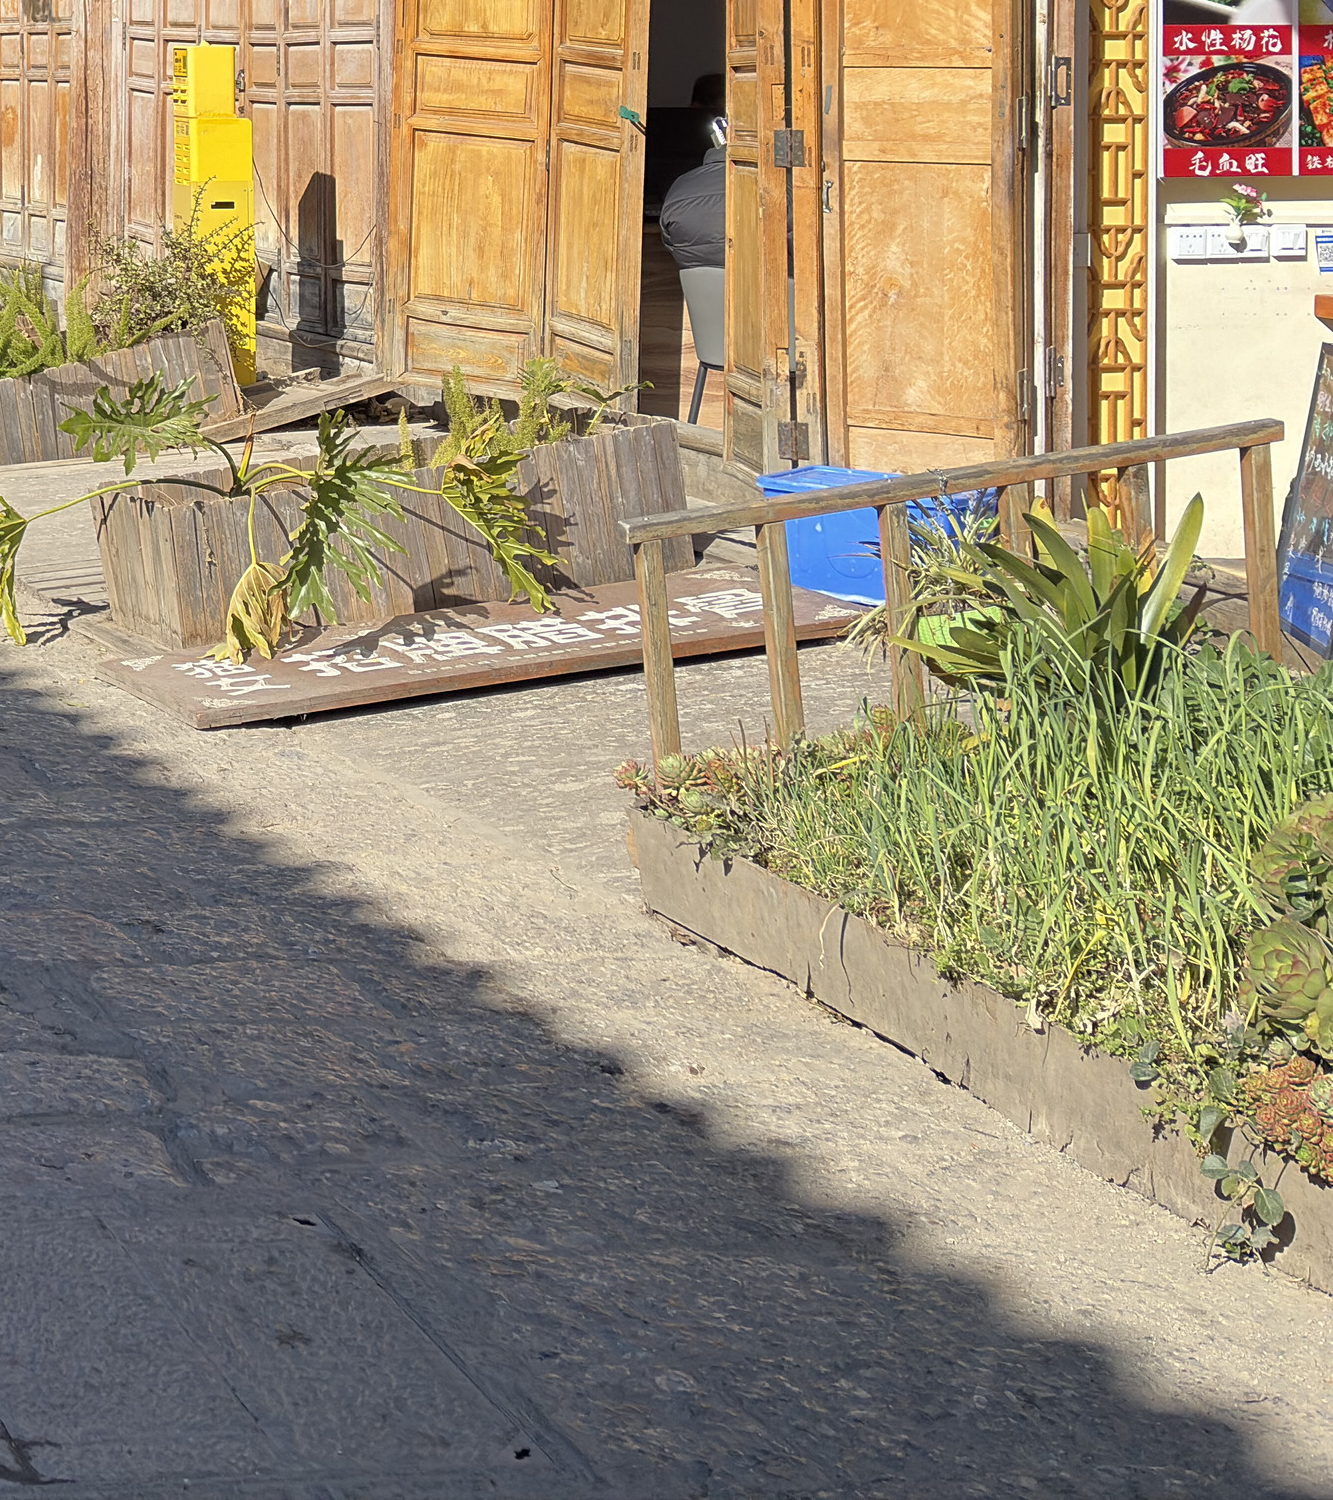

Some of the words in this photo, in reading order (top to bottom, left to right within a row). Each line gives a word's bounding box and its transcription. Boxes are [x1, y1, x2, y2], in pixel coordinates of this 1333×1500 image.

[1173, 28, 1282, 52] 水性杨花
[1189, 151, 1269, 176] 毛血旺
